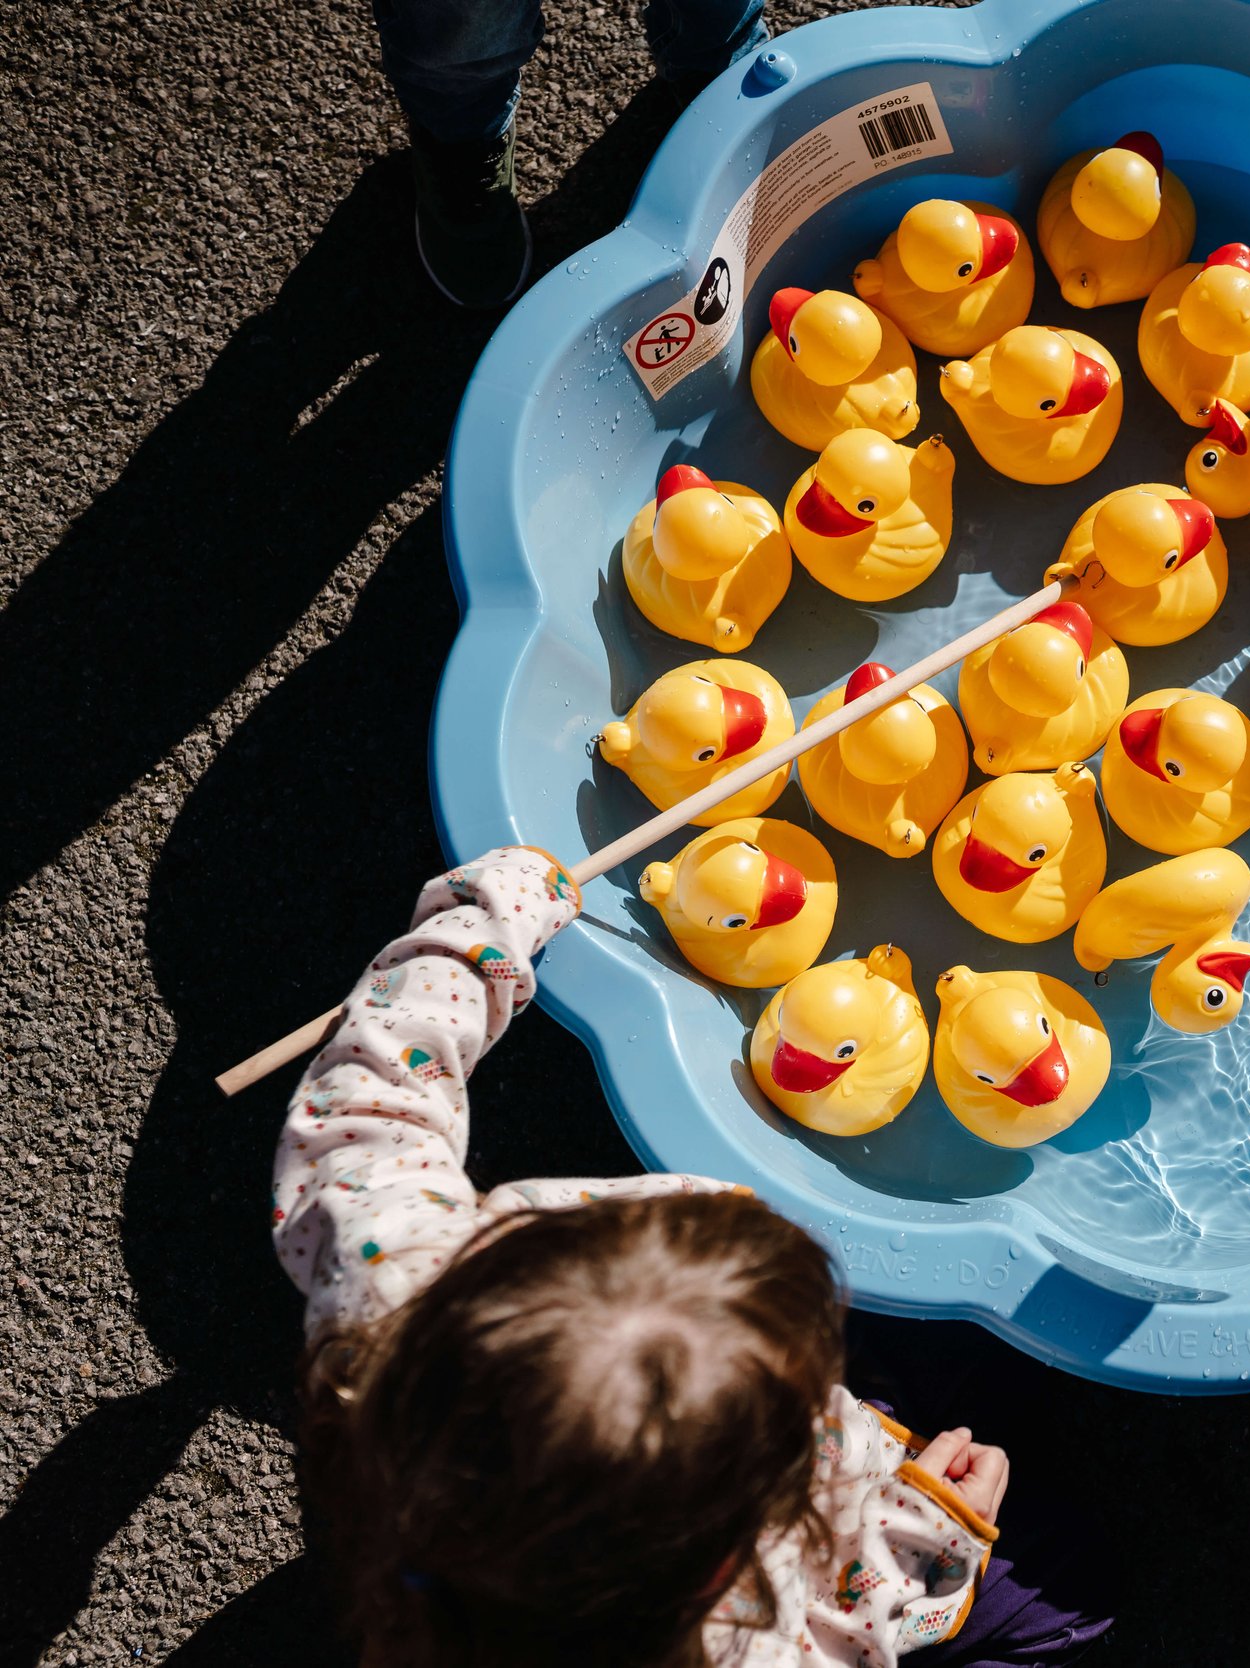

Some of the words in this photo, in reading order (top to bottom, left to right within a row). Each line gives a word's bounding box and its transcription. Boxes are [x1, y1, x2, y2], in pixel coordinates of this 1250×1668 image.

[857, 95, 911, 119] 4575902
[892, 148, 922, 161] 148915
[958, 1258, 1010, 1291] DO
